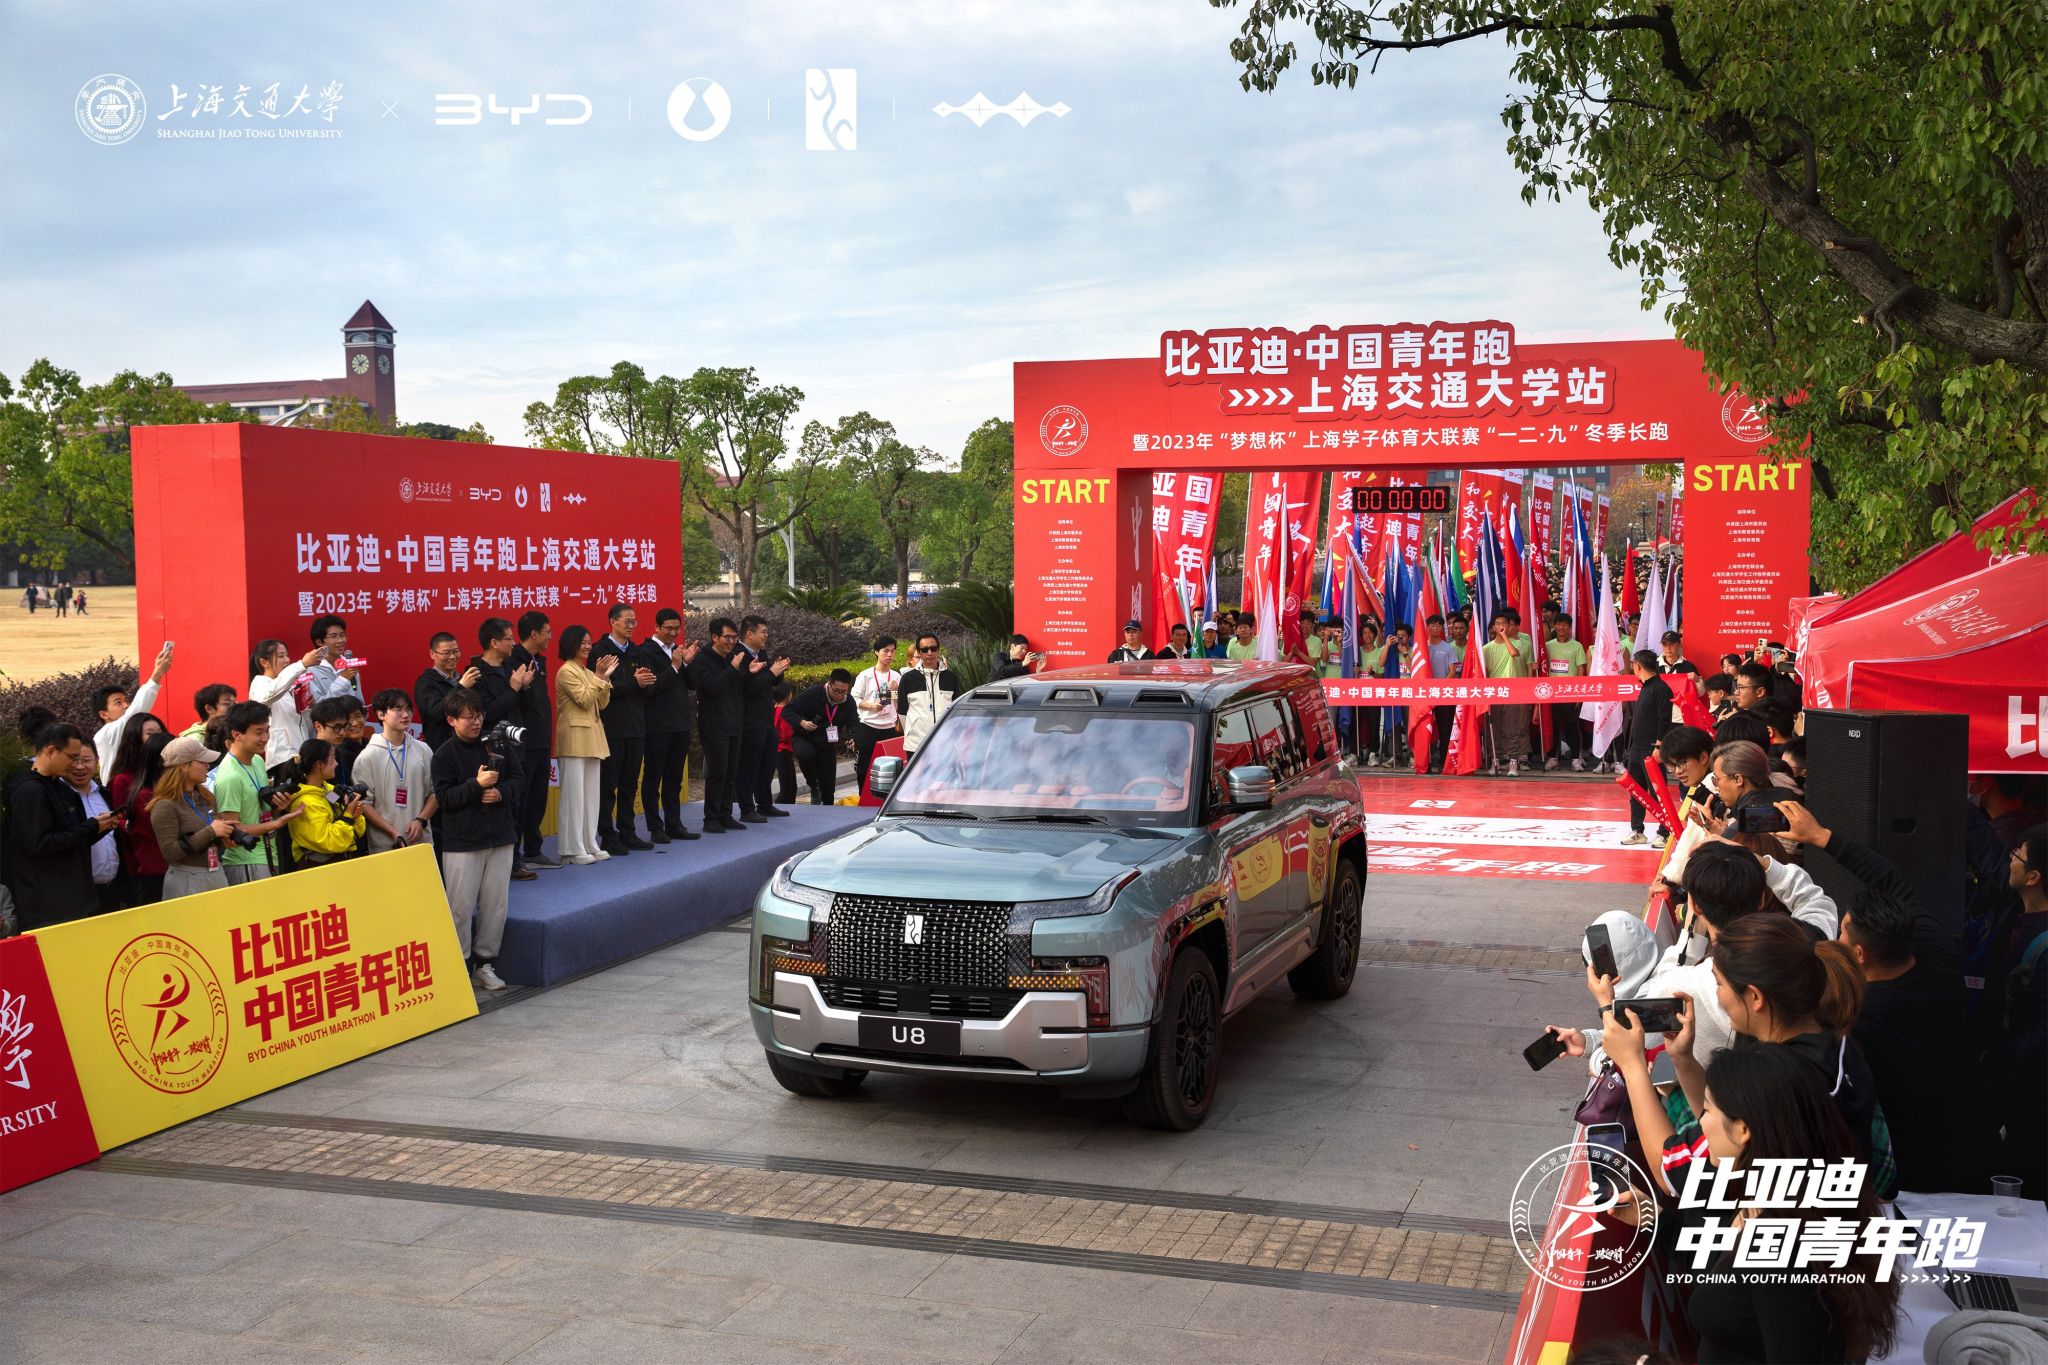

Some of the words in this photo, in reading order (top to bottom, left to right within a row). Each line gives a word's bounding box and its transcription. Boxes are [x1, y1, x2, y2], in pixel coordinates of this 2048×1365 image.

[1298, 365, 1607, 414] 上海交通大学站
[1021, 478, 1111, 504] START
[1693, 462, 1802, 491] START
[228, 903, 351, 985] 比亚迪
[243, 940, 433, 1043] 中国青年跑
[247, 1048, 267, 1063] BYD
[268, 1038, 297, 1056] CHINA
[297, 1027, 329, 1046] YOUTH
[329, 1011, 376, 1035] MARATHON
[892, 1025, 926, 1045] U8
[149, 1074, 174, 1089] CHINA
[177, 1077, 200, 1089] YOUTH
[0, 1101, 58, 1137] RSITY
